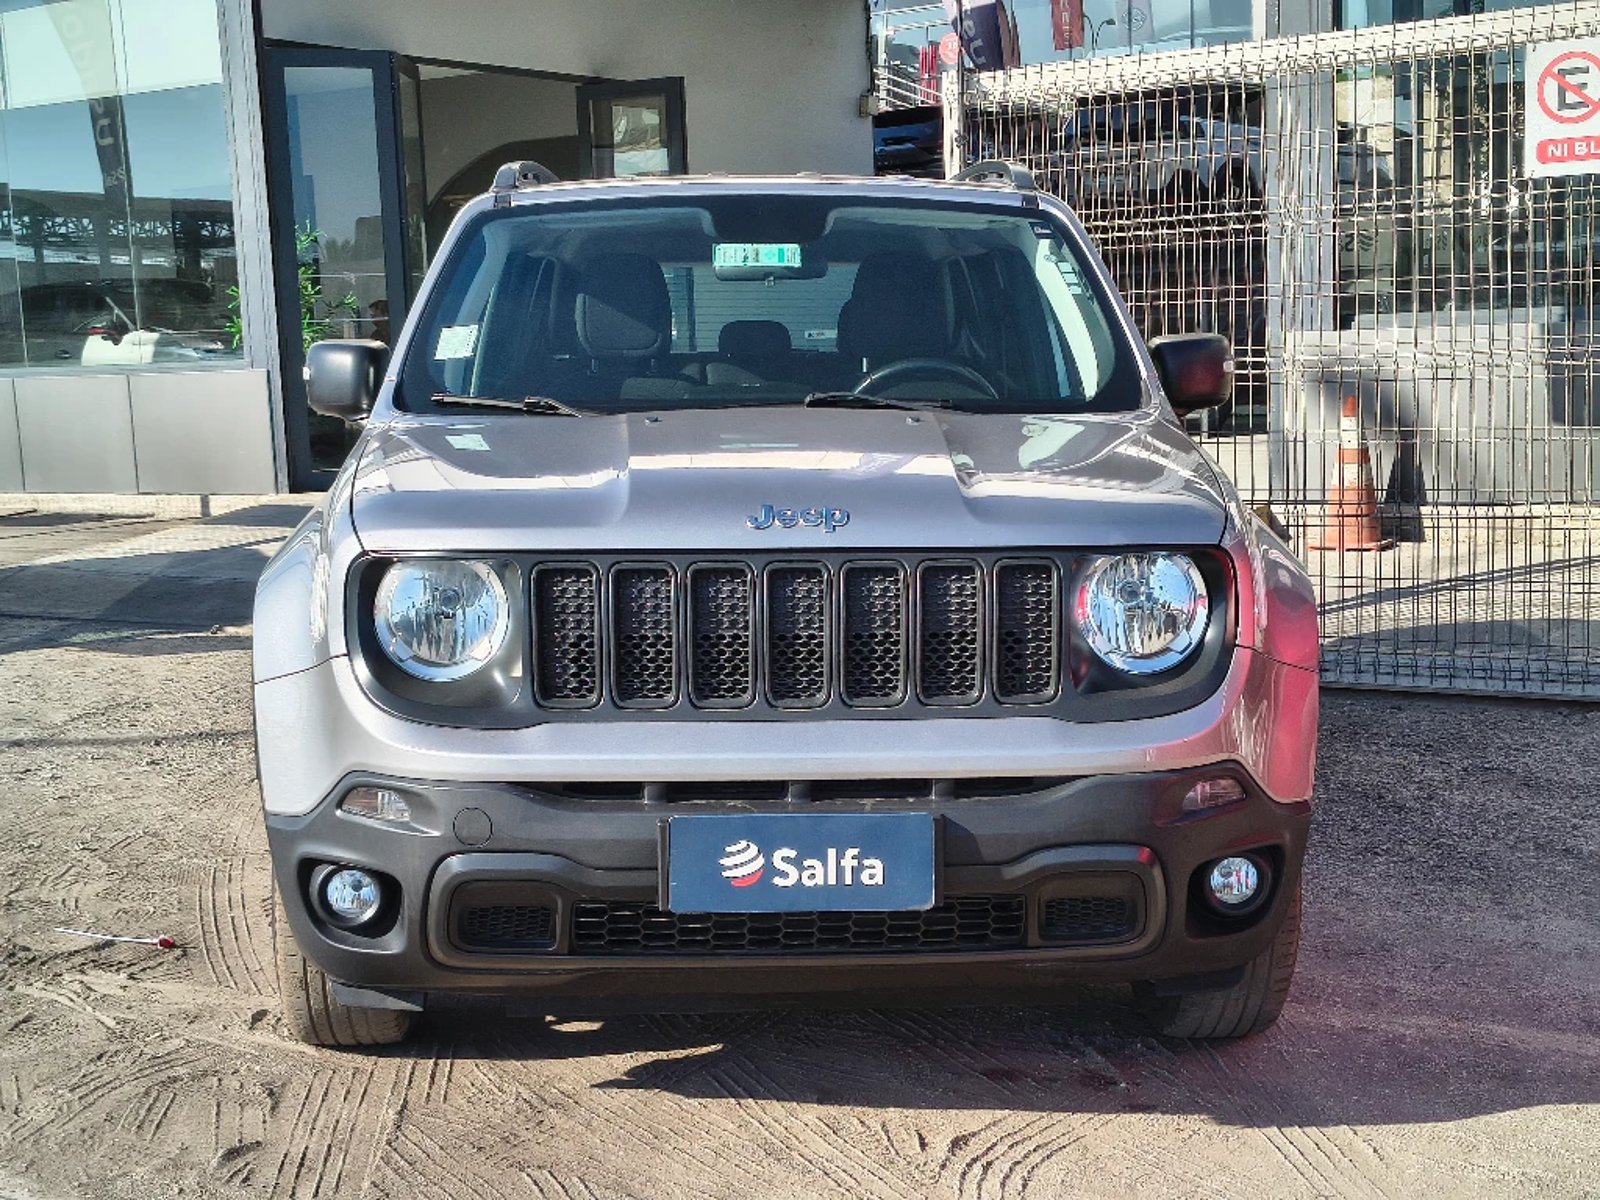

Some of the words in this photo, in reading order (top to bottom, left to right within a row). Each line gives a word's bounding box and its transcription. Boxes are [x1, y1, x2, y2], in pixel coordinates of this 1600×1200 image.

[1557, 66, 1590, 111] E
[1547, 143, 1568, 157] NI
[745, 503, 850, 533] Jeep
[771, 847, 885, 887] Salfa
